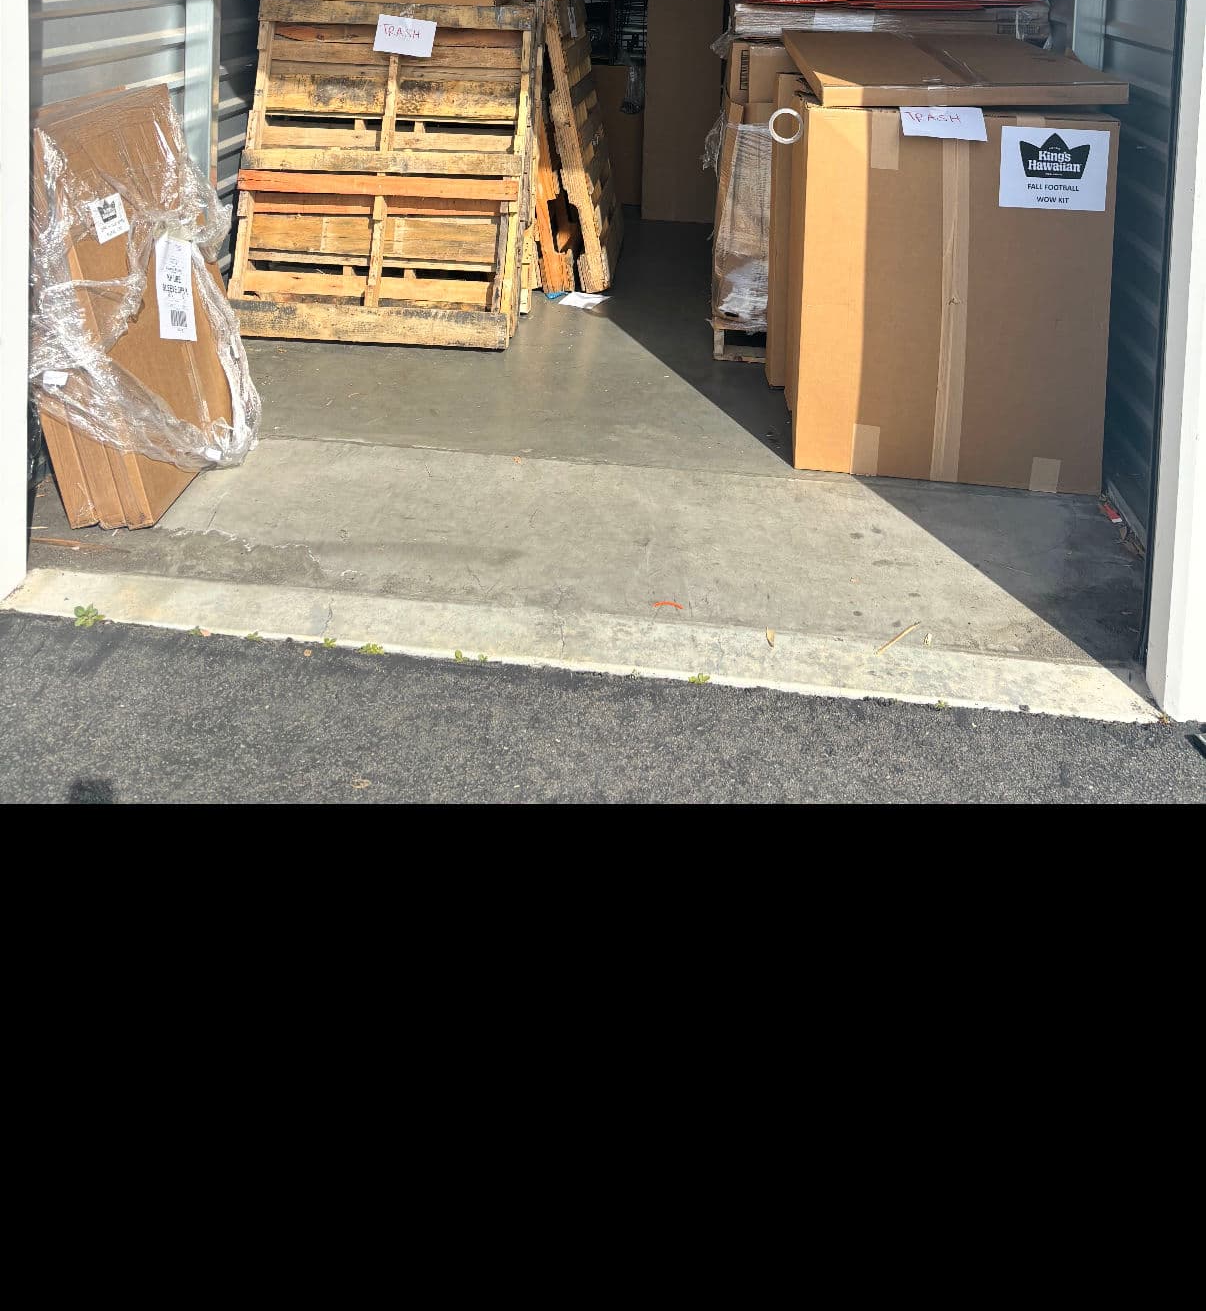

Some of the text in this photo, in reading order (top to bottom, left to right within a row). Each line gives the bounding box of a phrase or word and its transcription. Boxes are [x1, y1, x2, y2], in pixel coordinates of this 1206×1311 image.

[383, 23, 420, 39] TRASH
[905, 111, 961, 123] TRASH
[1038, 150, 1072, 163] King's
[1027, 159, 1081, 173] Hawaiian
[1027, 183, 1080, 192] FALL FOOTBALL
